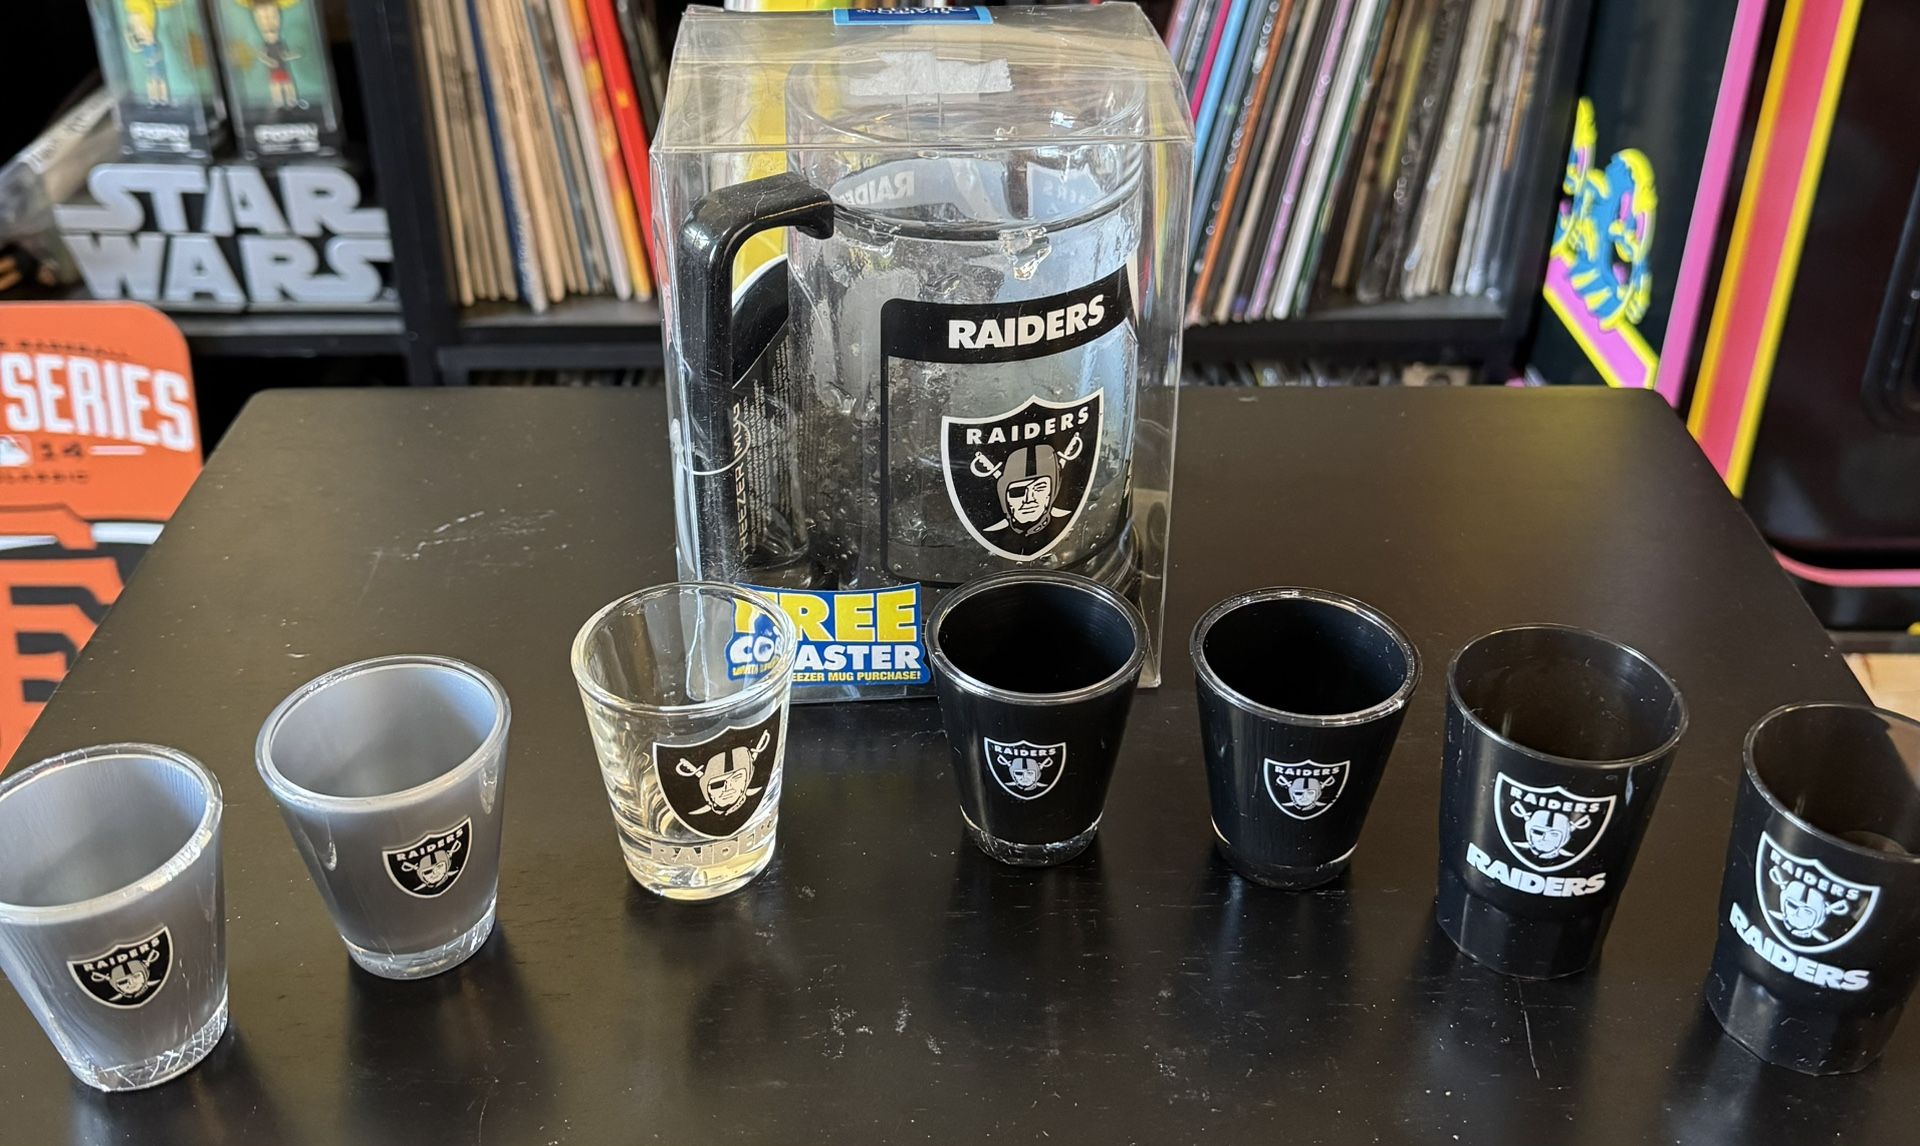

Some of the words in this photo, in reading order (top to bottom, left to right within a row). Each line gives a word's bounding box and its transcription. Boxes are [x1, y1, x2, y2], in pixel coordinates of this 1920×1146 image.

[54, 164, 390, 236] STAR
[62, 233, 394, 302] WARS
[947, 294, 1105, 349] RAIDERS
[2, 353, 194, 452] SERIES
[966, 405, 1090, 445] RAIDERS
[732, 587, 917, 643] FREE
[792, 672, 825, 682] EEZER
[828, 673, 854, 682] MUG
[857, 671, 921, 682] PURCHASE!
[994, 745, 1056, 757] RAIDERS
[1274, 766, 1340, 776] RAIDERS
[1510, 786, 1600, 813] RAIDERS
[396, 828, 463, 861] RAIDERS
[1466, 842, 1606, 897] RAIDERS
[1770, 849, 1860, 900] RAIDERS
[83, 937, 160, 972] RAIDERS
[1729, 902, 1870, 991] RAIDERS
